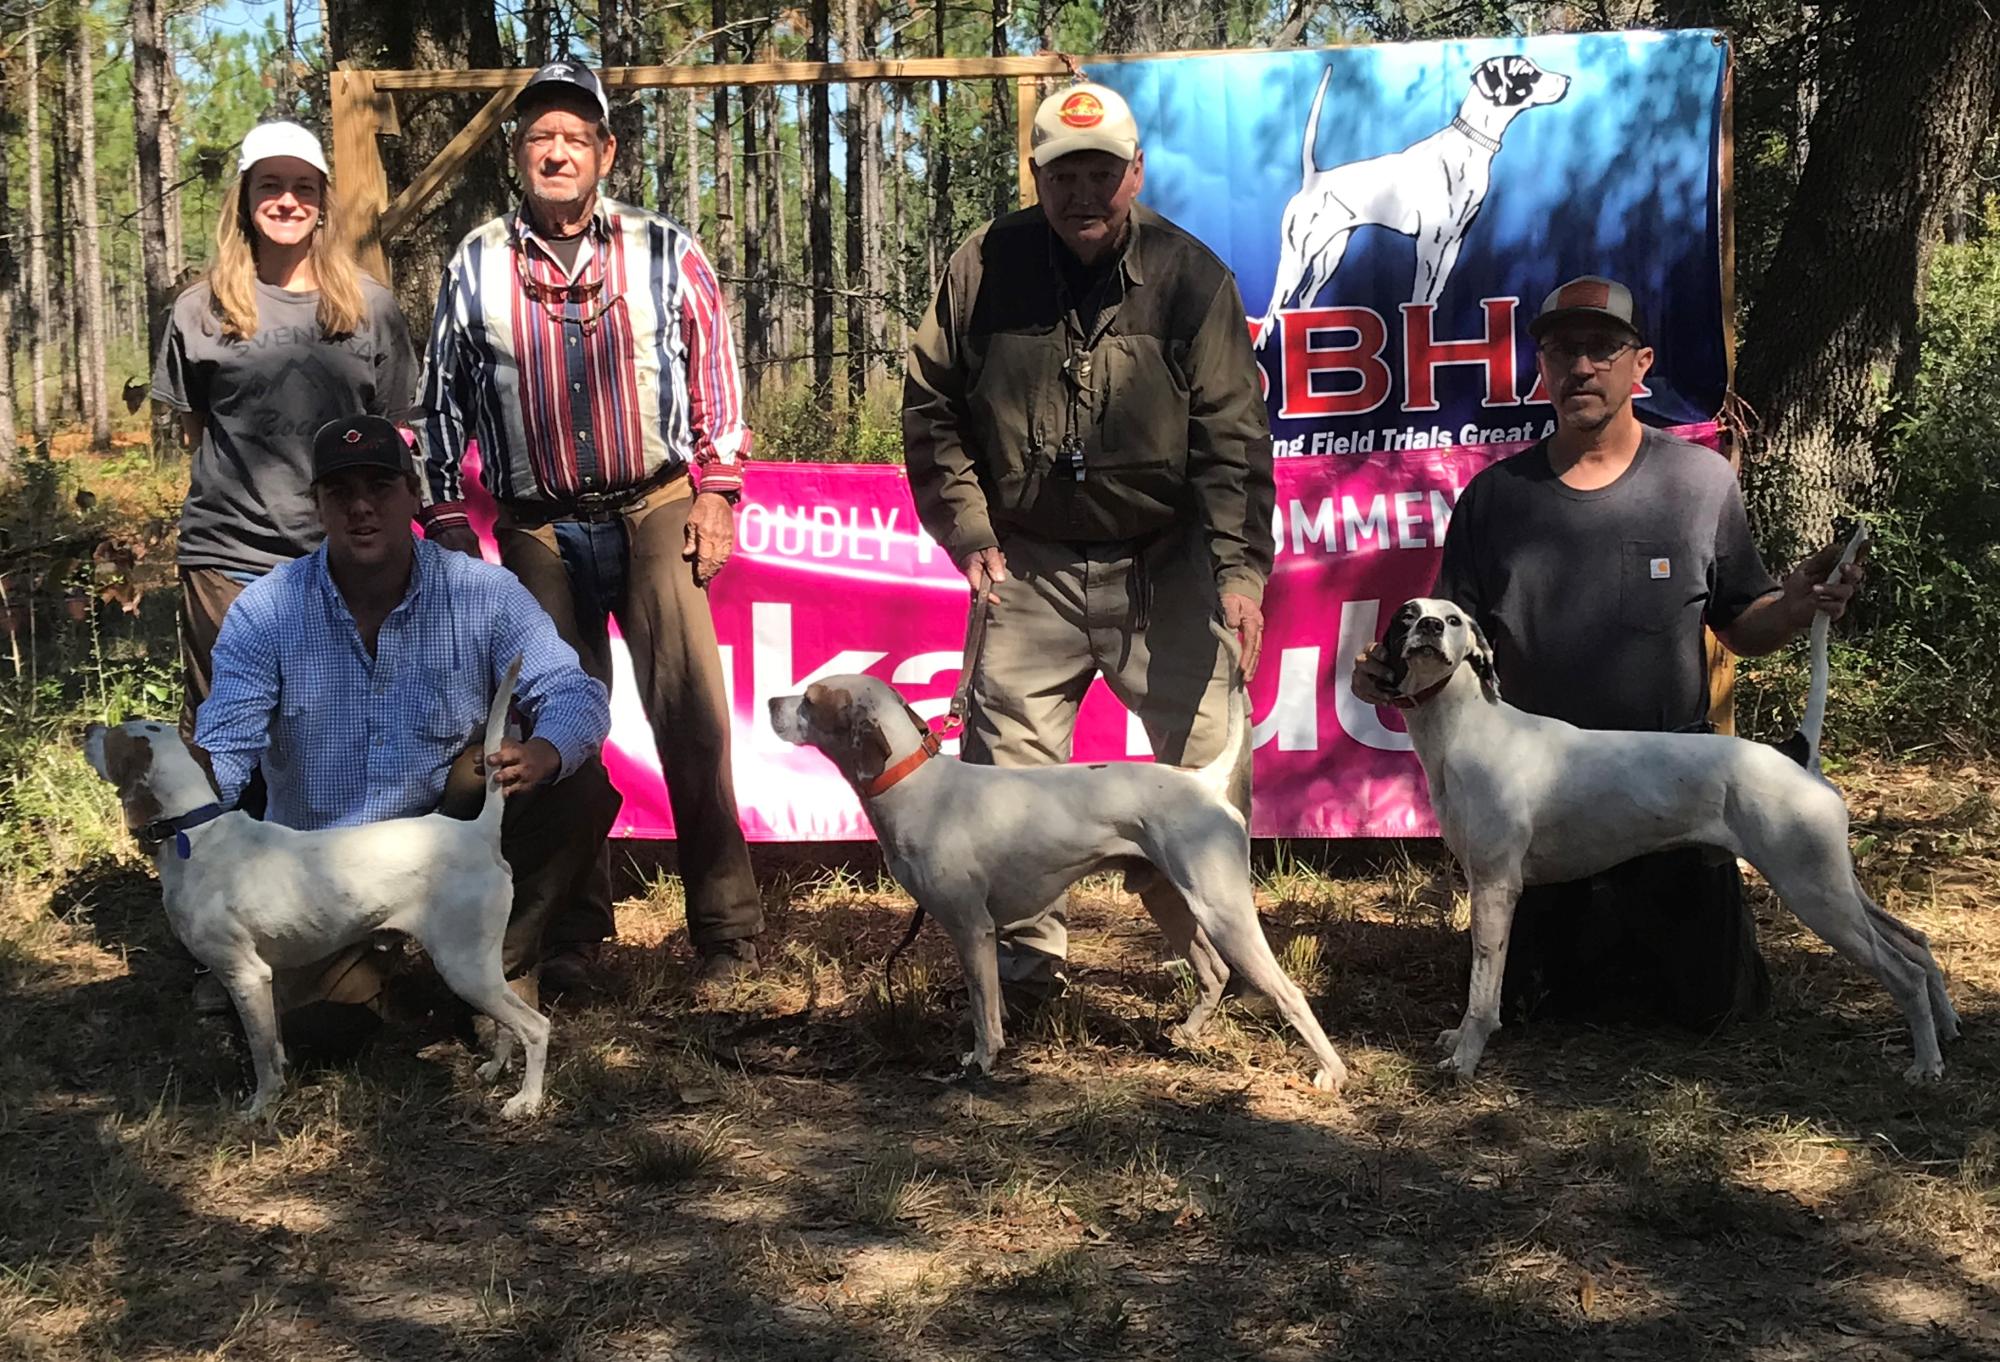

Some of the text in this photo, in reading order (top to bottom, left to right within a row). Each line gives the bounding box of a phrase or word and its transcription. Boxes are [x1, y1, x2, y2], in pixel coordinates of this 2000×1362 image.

[1310, 430, 1375, 456] Field
[1382, 426, 1453, 451] Trials
[1459, 421, 1534, 446] Great
